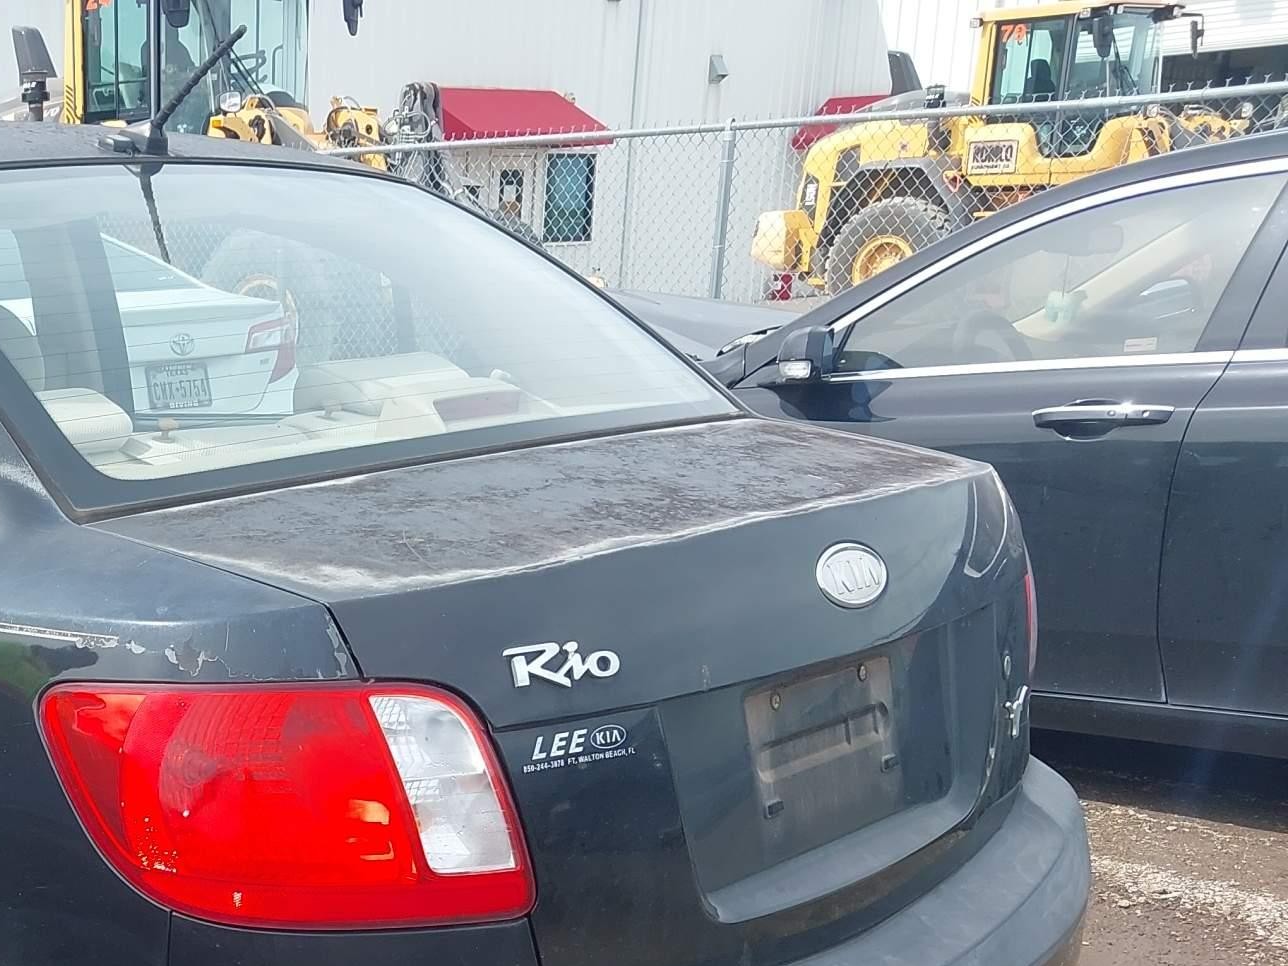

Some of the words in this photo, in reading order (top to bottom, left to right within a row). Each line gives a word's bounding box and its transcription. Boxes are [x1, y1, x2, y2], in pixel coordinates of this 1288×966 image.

[826, 555, 881, 596] KIA
[502, 640, 621, 688] Rio
[532, 728, 588, 761] LEE
[595, 729, 622, 746] KIA
[578, 751, 605, 763] WALTON
[628, 746, 636, 754] FL
